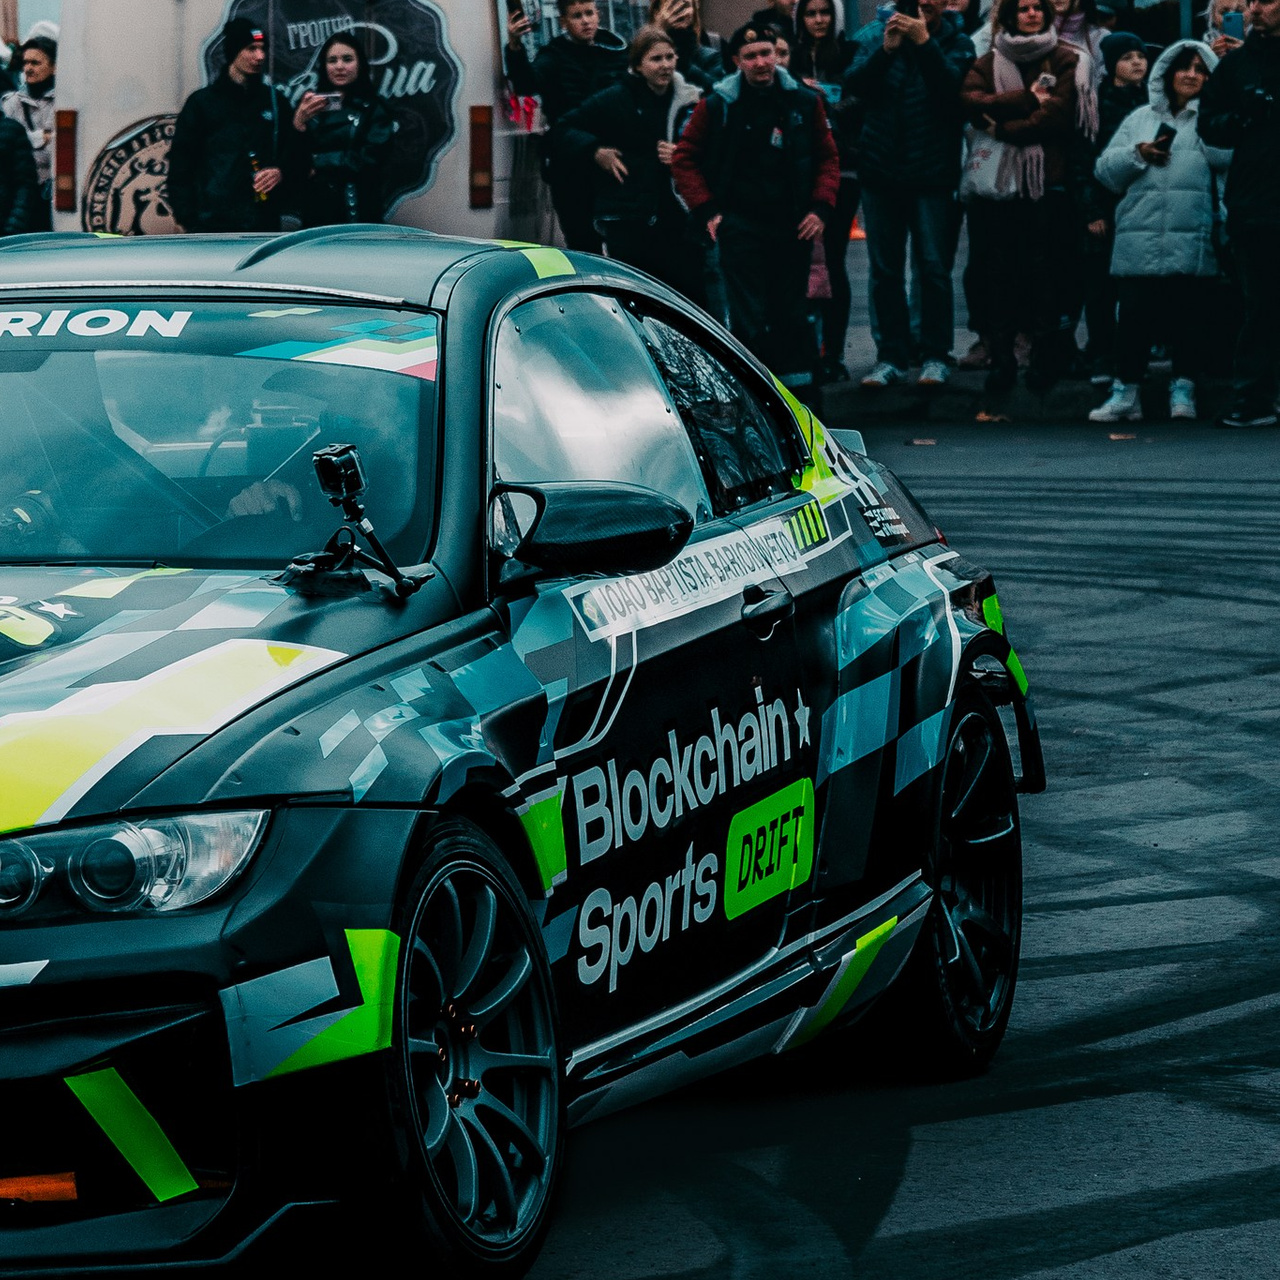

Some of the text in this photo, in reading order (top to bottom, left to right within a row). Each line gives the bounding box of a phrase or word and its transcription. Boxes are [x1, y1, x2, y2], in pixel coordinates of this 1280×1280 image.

[641, 557, 712, 606] BAPTISTA
[705, 537, 765, 582] BARION
[754, 531, 798, 569] NETO
[572, 685, 791, 866] Blockchain
[577, 806, 805, 993] Sports DRIFT
